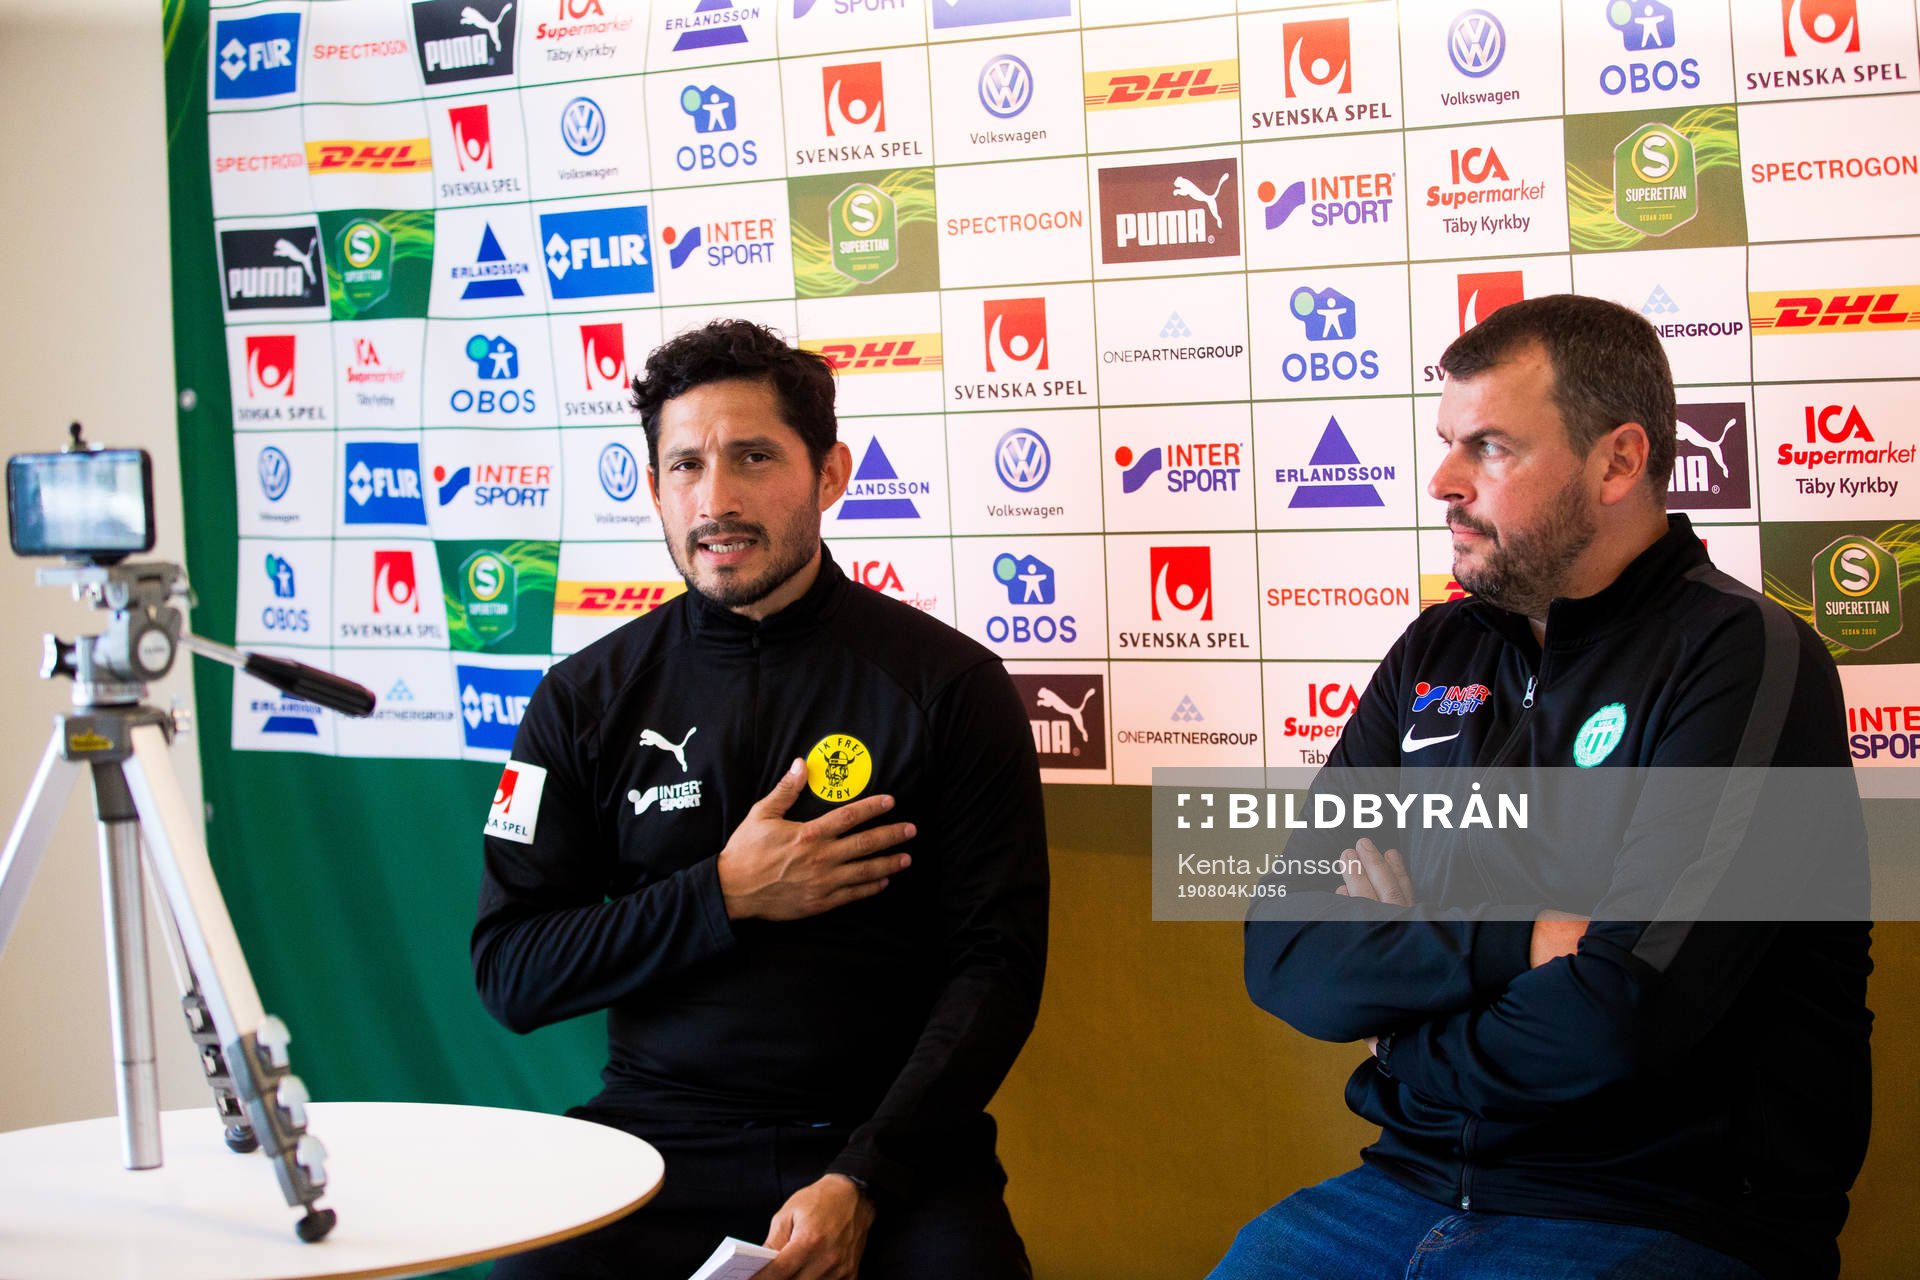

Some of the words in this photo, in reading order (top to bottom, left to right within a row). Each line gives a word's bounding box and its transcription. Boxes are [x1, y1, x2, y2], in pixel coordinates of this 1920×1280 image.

[665, 7, 760, 31] ERLANDSSON
[424, 34, 488, 72] PUMA
[1108, 68, 1220, 104] DHL
[1600, 58, 1700, 95] OBOS
[1747, 66, 1846, 90] SVENSKA
[1853, 63, 1907, 83] SPEL
[1441, 87, 1520, 107] Volkswagen
[1251, 106, 1339, 129] SVENSKA
[1345, 103, 1392, 121] SPEL
[970, 129, 1047, 145] Volkswagen
[319, 145, 417, 168] DHL
[677, 140, 757, 171] OBOS
[796, 145, 874, 165] SVENSKA
[881, 141, 922, 158] SPEL
[1450, 146, 1510, 184] ICA
[558, 166, 619, 181] Volkswagen
[1751, 156, 1919, 183] SPECTROGON
[1312, 173, 1393, 200] INTER
[1427, 180, 1546, 209] Supermarket
[1625, 186, 1687, 202] SUPERETTAN
[947, 211, 1082, 236] SPECTROGON
[1312, 199, 1394, 227] SPORT
[707, 219, 775, 243] INTER
[1116, 208, 1207, 248] PUMA
[1443, 218, 1477, 237] Täby
[1481, 214, 1531, 234] Kyrkby
[570, 234, 649, 270] FLIR
[708, 242, 775, 267] SPORT
[229, 266, 304, 299] PUMA
[451, 263, 530, 279] ERLANDSSON
[1775, 293, 1909, 328] DHL
[821, 340, 921, 368] DHL
[1103, 345, 1243, 364] ONEPARTNERGROUP
[1282, 349, 1379, 382] OBOS
[450, 389, 536, 414] OBOS
[954, 382, 1037, 400] SVENSKA
[1043, 380, 1087, 397] SPEL
[289, 407, 327, 420] SPEL
[565, 401, 625, 416] SVENSKA
[1805, 404, 1875, 444] ICA
[1167, 443, 1240, 467] INTER
[1777, 441, 1917, 469] Supermarket
[372, 467, 421, 500] FLIR
[476, 465, 550, 485] INTER
[1167, 468, 1241, 493] SPORT
[1276, 466, 1395, 483] ERLANDSSON
[474, 486, 549, 507] SPORT
[846, 482, 930, 496] LANDSSON
[1796, 478, 1835, 498] Täby
[1839, 477, 1899, 497] Kyrkby
[987, 505, 1064, 519] Volkswagen
[853, 560, 905, 592] ICA
[578, 588, 665, 611] DHL
[1267, 588, 1410, 606] SPECTROGON
[1825, 601, 1890, 616] SUPERETTAN
[262, 607, 310, 633] OBOS
[341, 624, 414, 638] SVENSKA
[986, 615, 1077, 643] OBOS
[1119, 633, 1200, 648] SVENSKA
[1207, 632, 1250, 648] SPEL
[1849, 706, 1920, 732] INTE
[818, 741, 830, 753] IK
[838, 738, 864, 756] FREJ
[1118, 731, 1258, 746] ONEPARTNERGROUP
[659, 780, 700, 799] INTER
[660, 793, 702, 812] SPORT
[502, 820, 529, 836] SPEL
